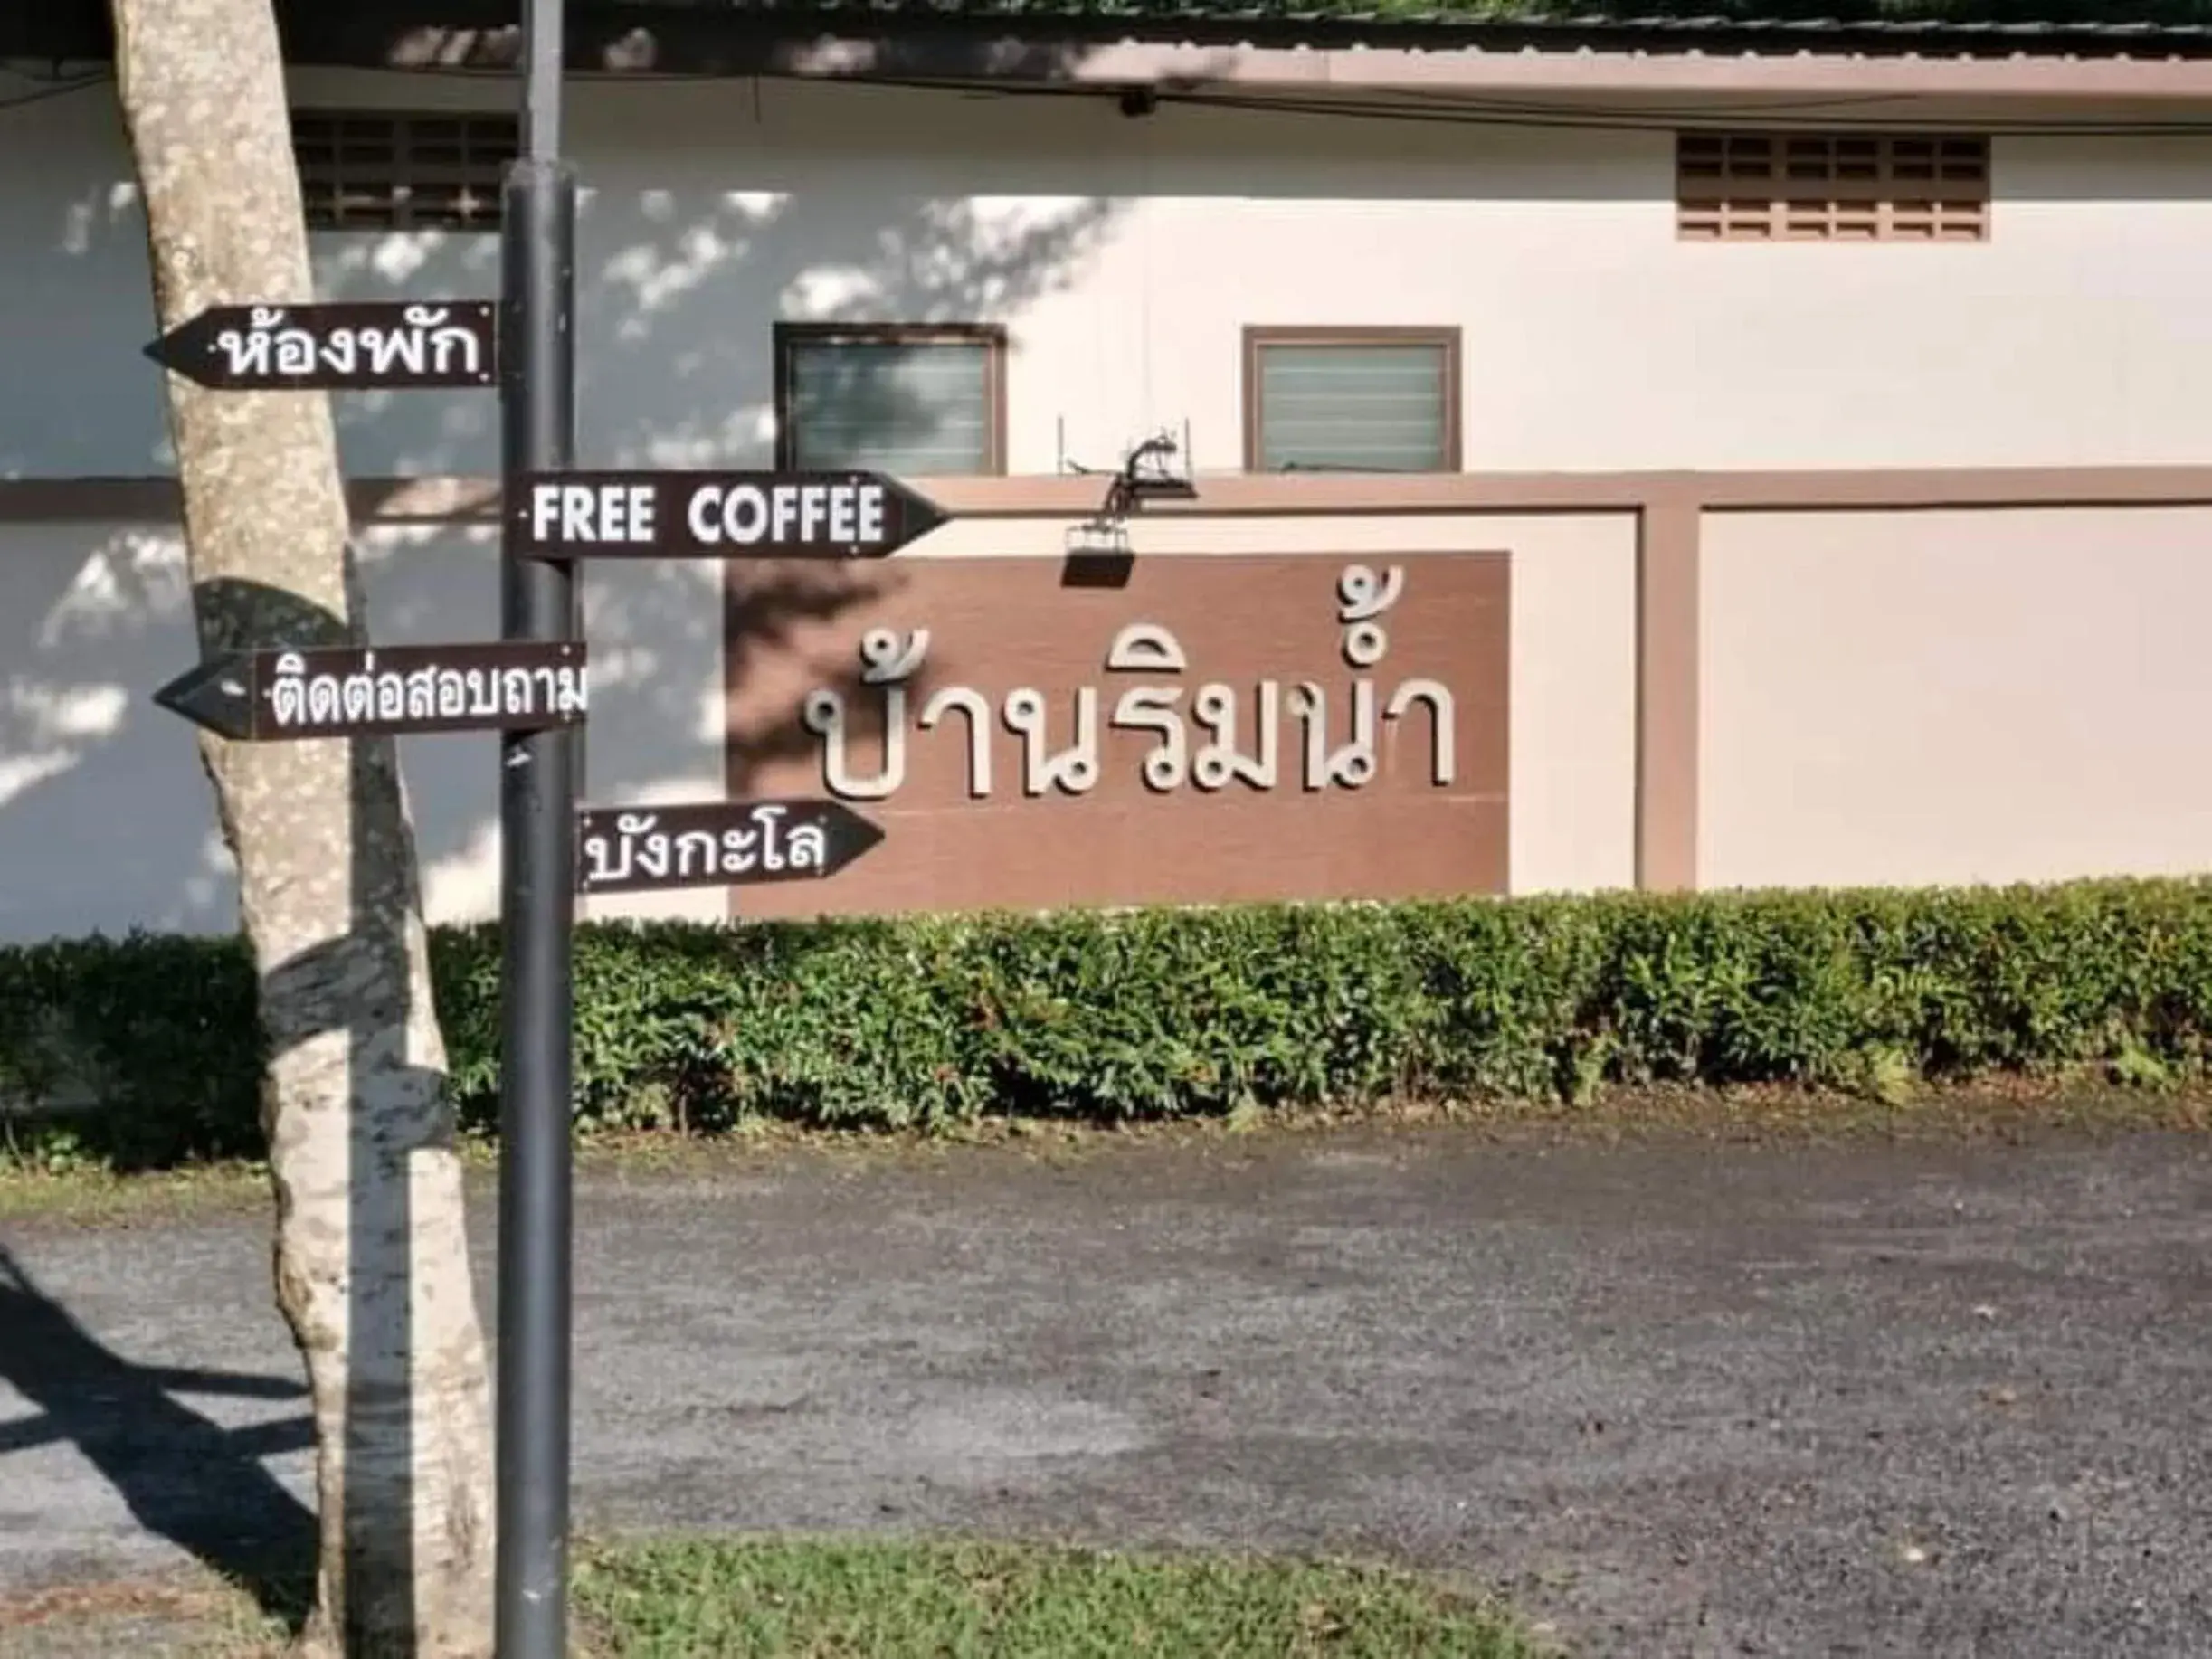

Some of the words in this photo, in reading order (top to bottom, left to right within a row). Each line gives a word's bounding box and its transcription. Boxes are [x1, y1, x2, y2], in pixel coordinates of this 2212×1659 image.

[216, 304, 479, 375] ห้องพัก
[532, 484, 656, 543] FREE
[688, 484, 884, 544] COFFEE
[271, 652, 587, 726] ติดต่อสอบถาม
[805, 564, 1455, 799] บ้านริมน้ำ
[584, 806, 825, 880] บังกะโล
